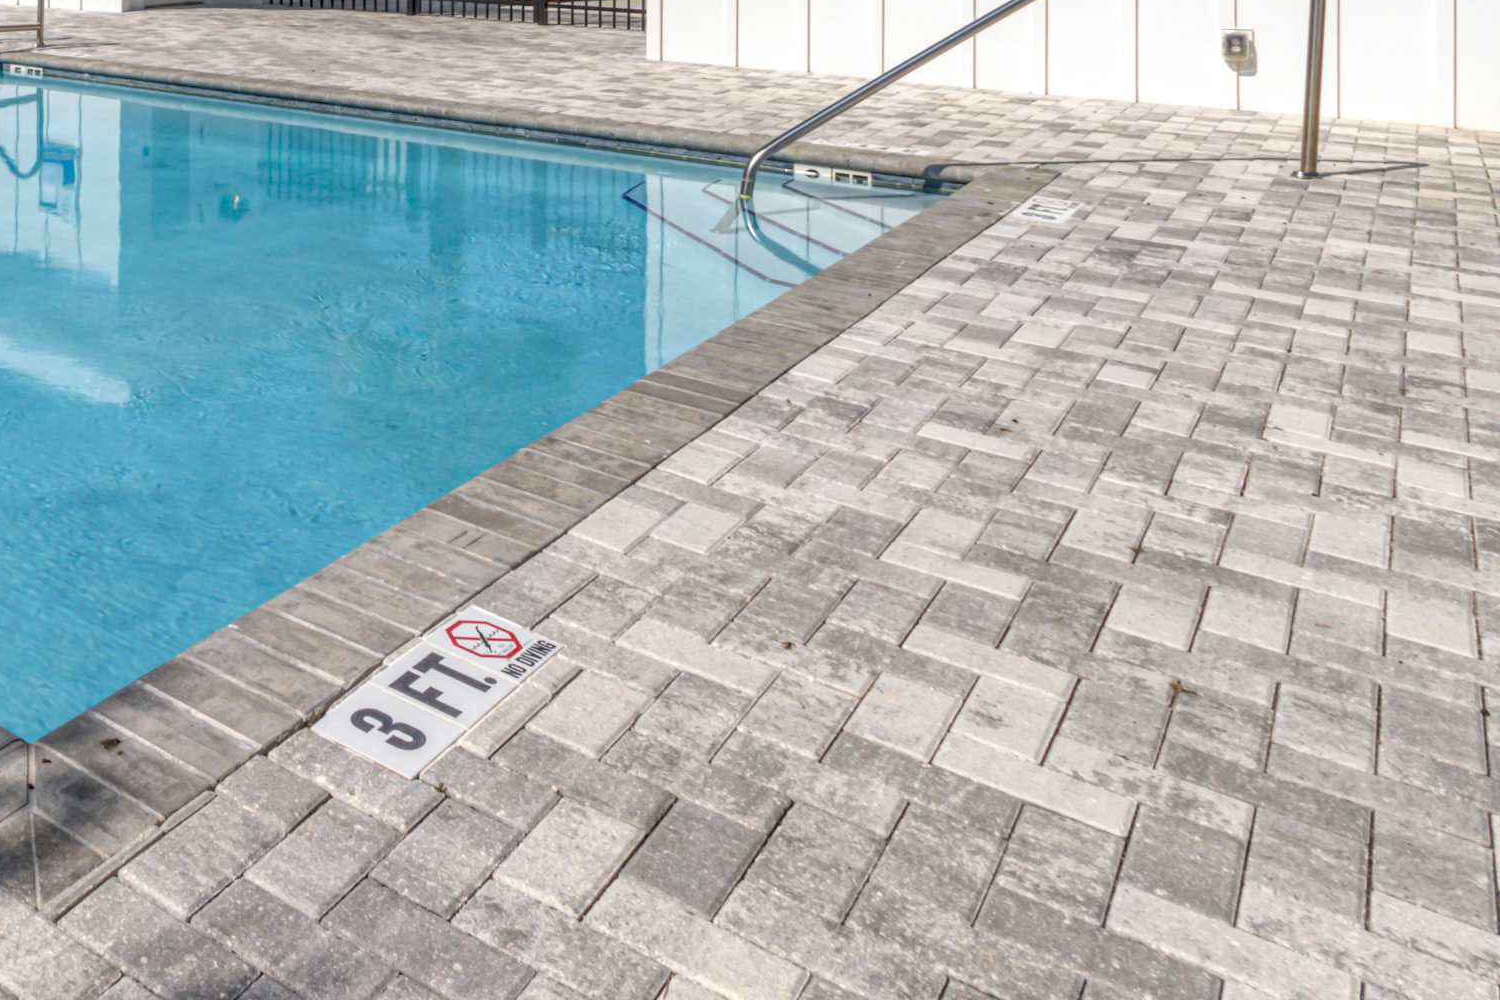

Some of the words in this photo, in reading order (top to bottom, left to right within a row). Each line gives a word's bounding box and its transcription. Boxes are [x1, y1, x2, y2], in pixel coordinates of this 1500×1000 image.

[501, 656, 527, 679] NO
[518, 639, 557, 668] DIVING
[388, 651, 498, 719] FT.
[350, 707, 427, 751] 3
